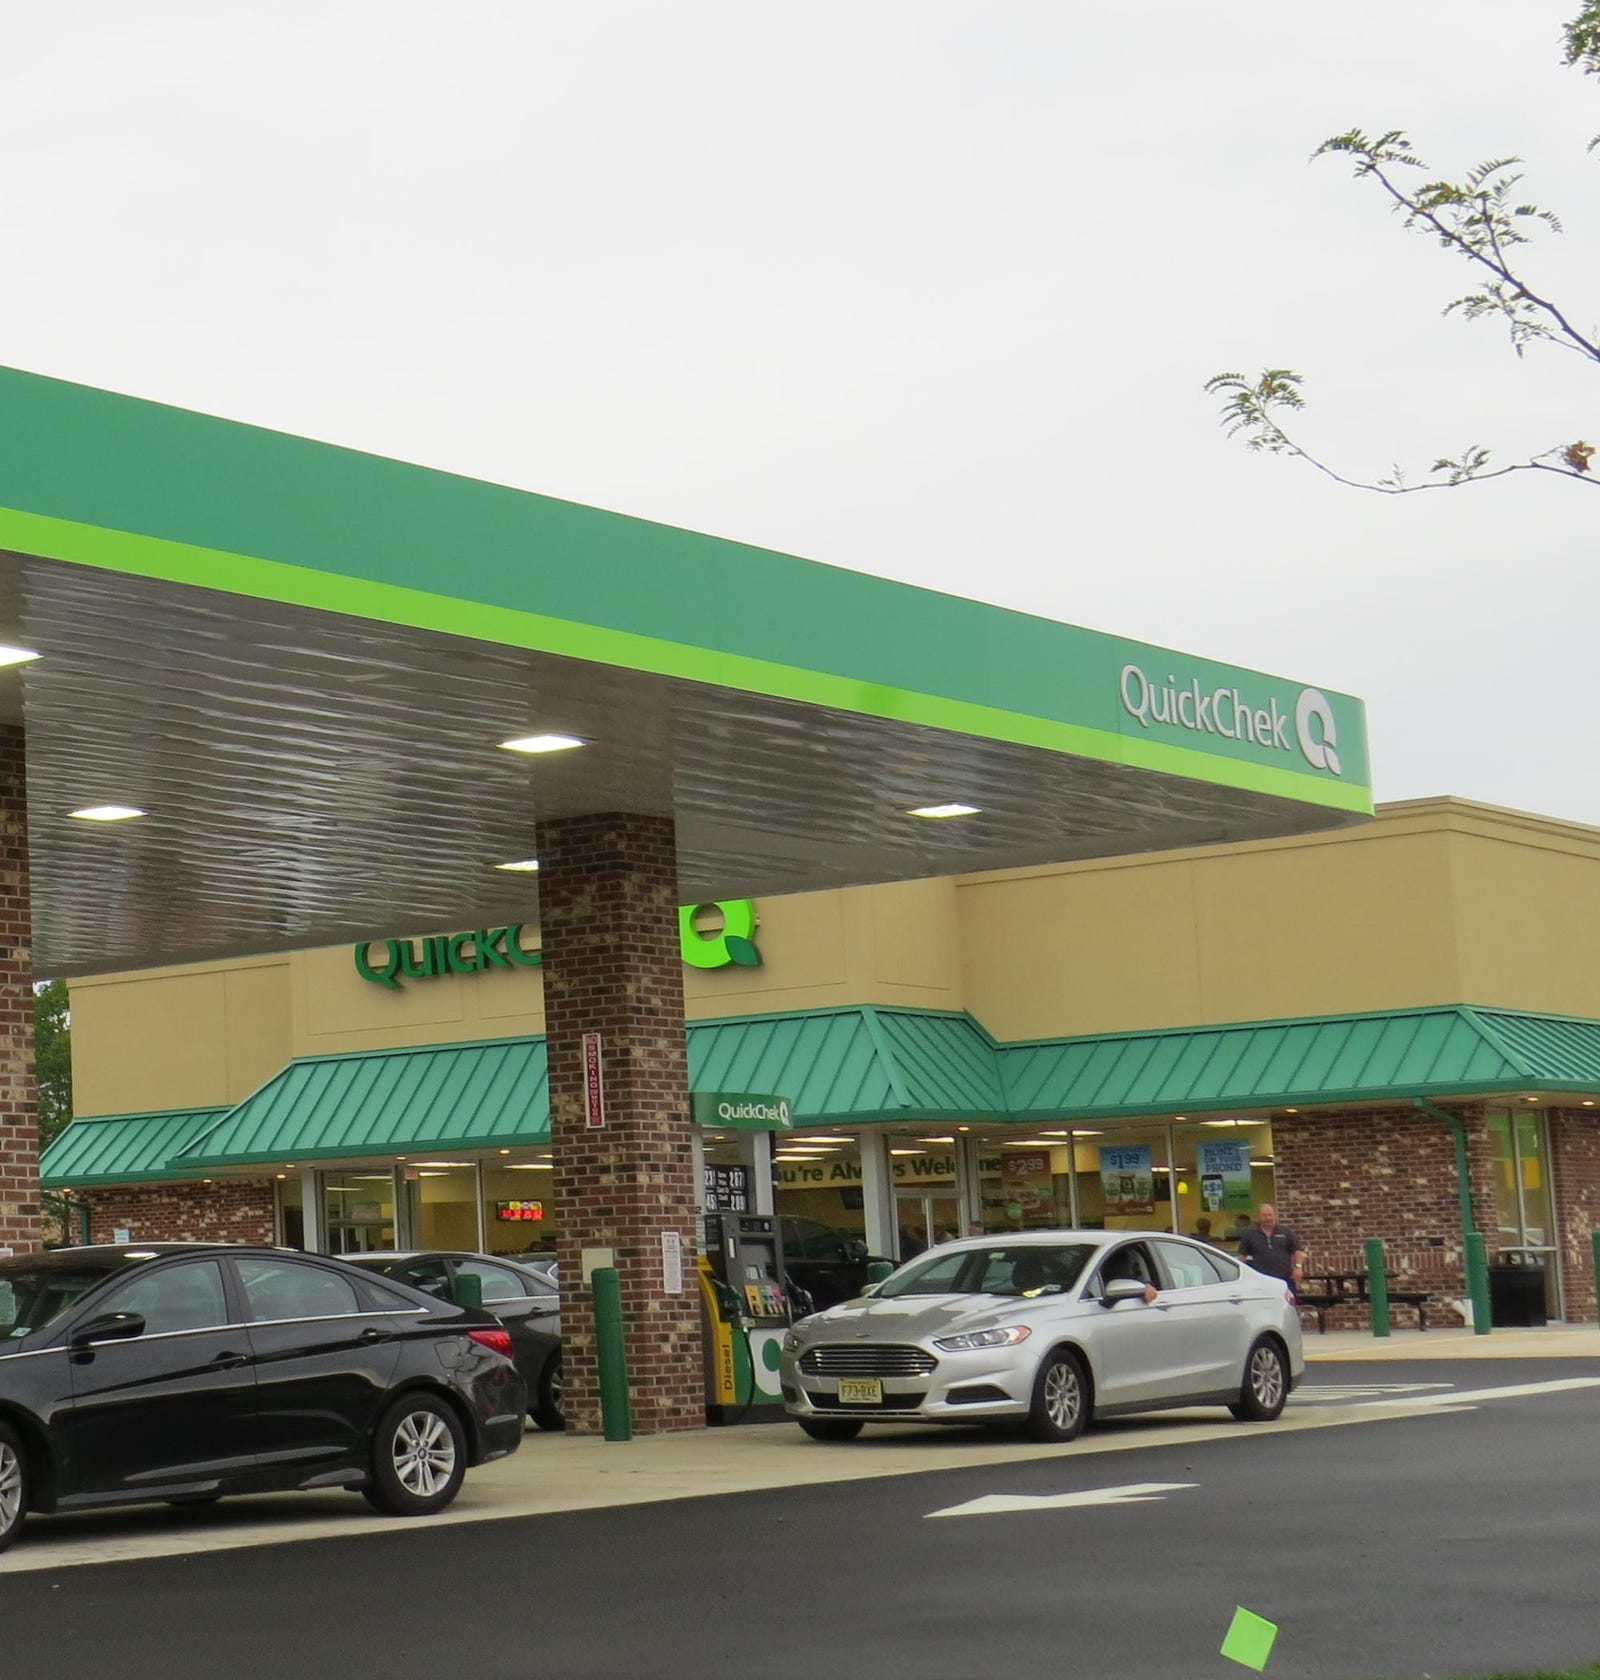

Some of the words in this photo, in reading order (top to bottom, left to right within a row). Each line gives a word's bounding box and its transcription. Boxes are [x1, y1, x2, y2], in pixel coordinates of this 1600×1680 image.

[1119, 664, 1291, 752] QuickChek
[354, 923, 544, 991] QuickC
[587, 1045, 599, 1089] SMOKING
[718, 1101, 780, 1121] QuickChek
[721, 1344, 733, 1390] Diesel
